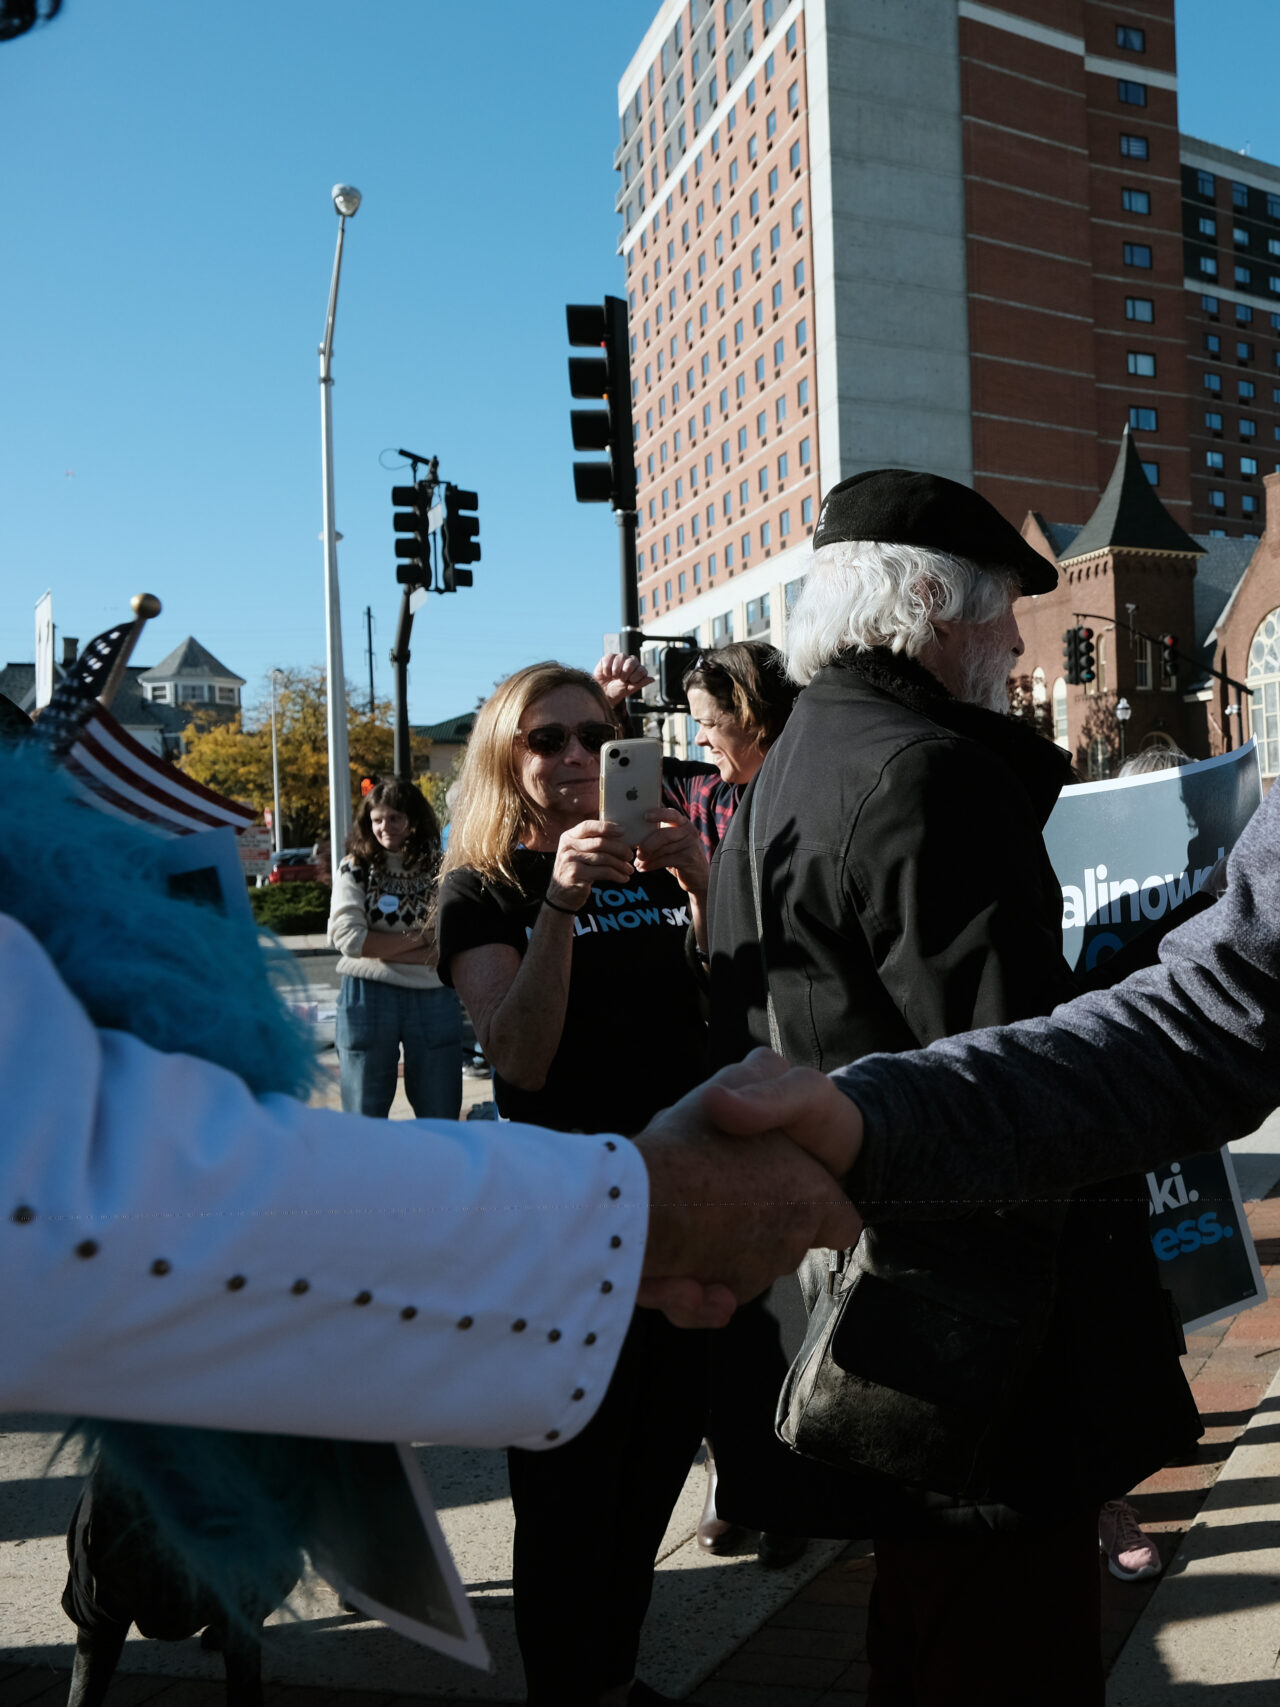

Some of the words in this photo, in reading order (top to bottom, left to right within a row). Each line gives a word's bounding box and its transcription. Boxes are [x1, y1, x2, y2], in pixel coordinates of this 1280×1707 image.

[591, 886, 650, 908] TOM
[1062, 846, 1225, 930] alinow
[525, 905, 691, 942] LINOWSK
[1152, 1211, 1234, 1262] ess.
